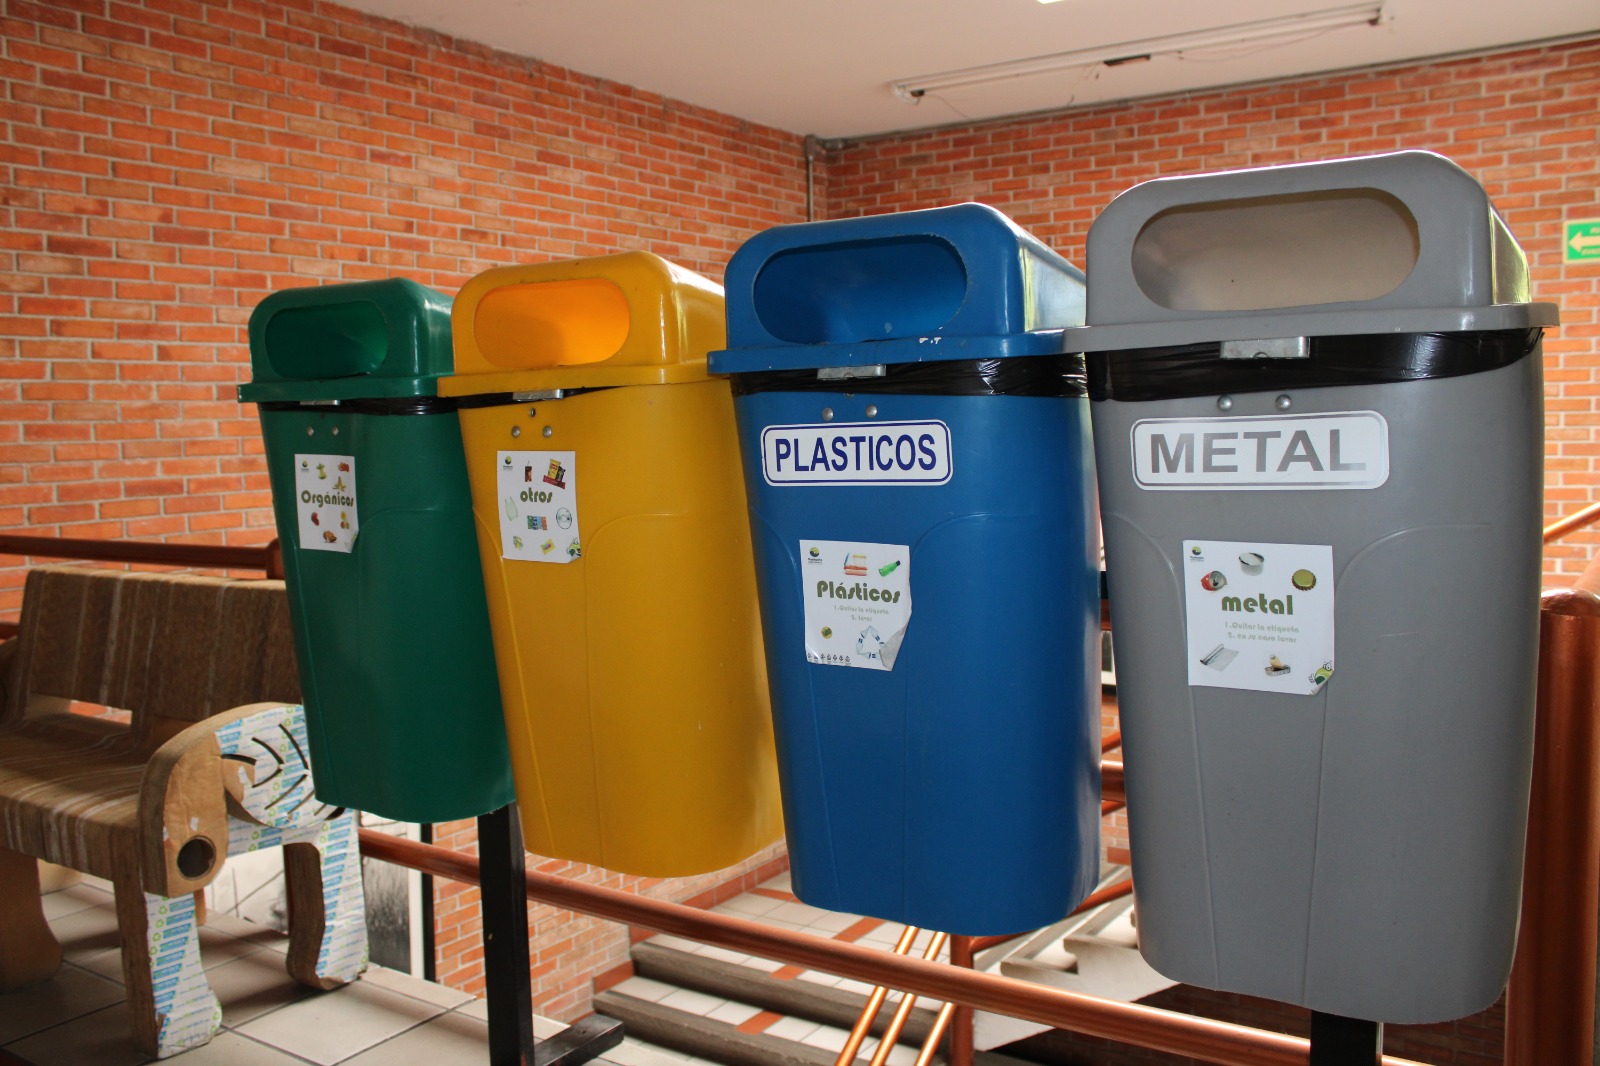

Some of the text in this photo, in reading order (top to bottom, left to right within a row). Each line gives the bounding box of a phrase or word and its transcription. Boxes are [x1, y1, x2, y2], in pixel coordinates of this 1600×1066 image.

[775, 434, 937, 472] PLASTICOS
[1150, 429, 1367, 474] METAL
[301, 490, 354, 508] Orgánicos
[520, 487, 553, 503] otros
[817, 580, 900, 604] Plásticos
[1222, 593, 1293, 615] metal
[1248, 633, 1256, 641] su
[1257, 623, 1265, 631] la
[1266, 623, 1299, 634] etiqueta
